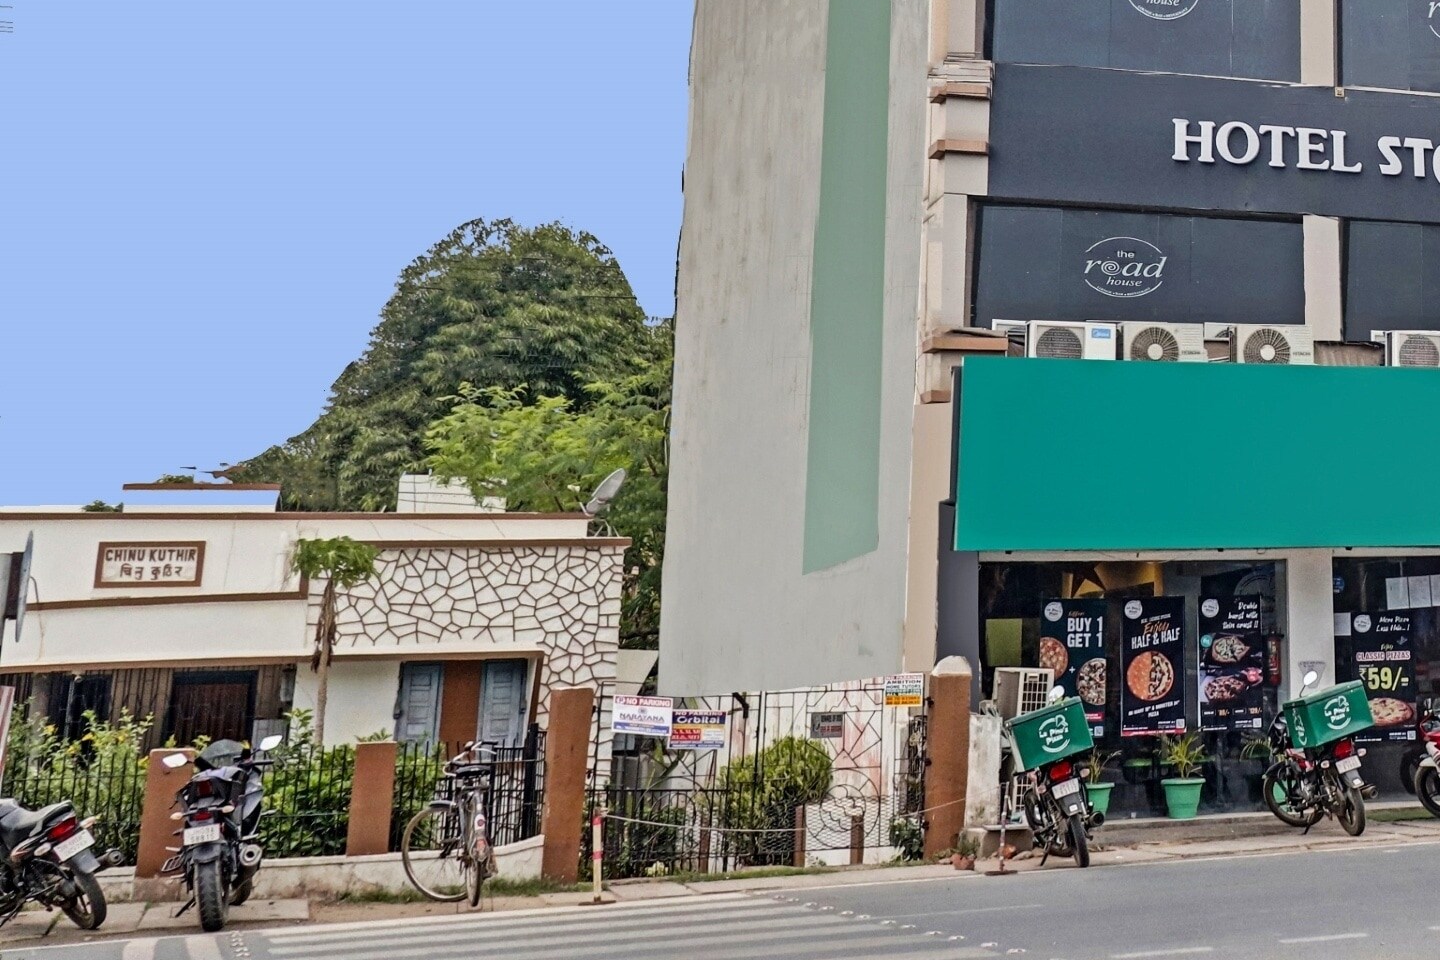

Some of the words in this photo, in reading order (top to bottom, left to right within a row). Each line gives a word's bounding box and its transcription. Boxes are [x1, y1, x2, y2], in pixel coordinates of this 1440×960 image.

[1171, 117, 1362, 174] HOTEL
[1116, 249, 1135, 258] the
[1084, 256, 1167, 278] road
[1105, 276, 1142, 286] house
[105, 549, 146, 561] CHINU
[148, 548, 196, 562] KUTHIR
[1067, 617, 1092, 632] BUY
[1096, 616, 1103, 632] 1
[1067, 633, 1091, 647] GET
[1096, 632, 1103, 647] 1
[1131, 634, 1151, 649] HALF
[1152, 632, 1160, 645] &
[1161, 627, 1180, 643] HALF
[1356, 651, 1385, 661] CLASSIC
[1386, 650, 1411, 660] PIZZAS
[639, 698, 670, 706] PARKING
[619, 713, 664, 722] NARAYANA
[677, 716, 720, 724] Orbital
